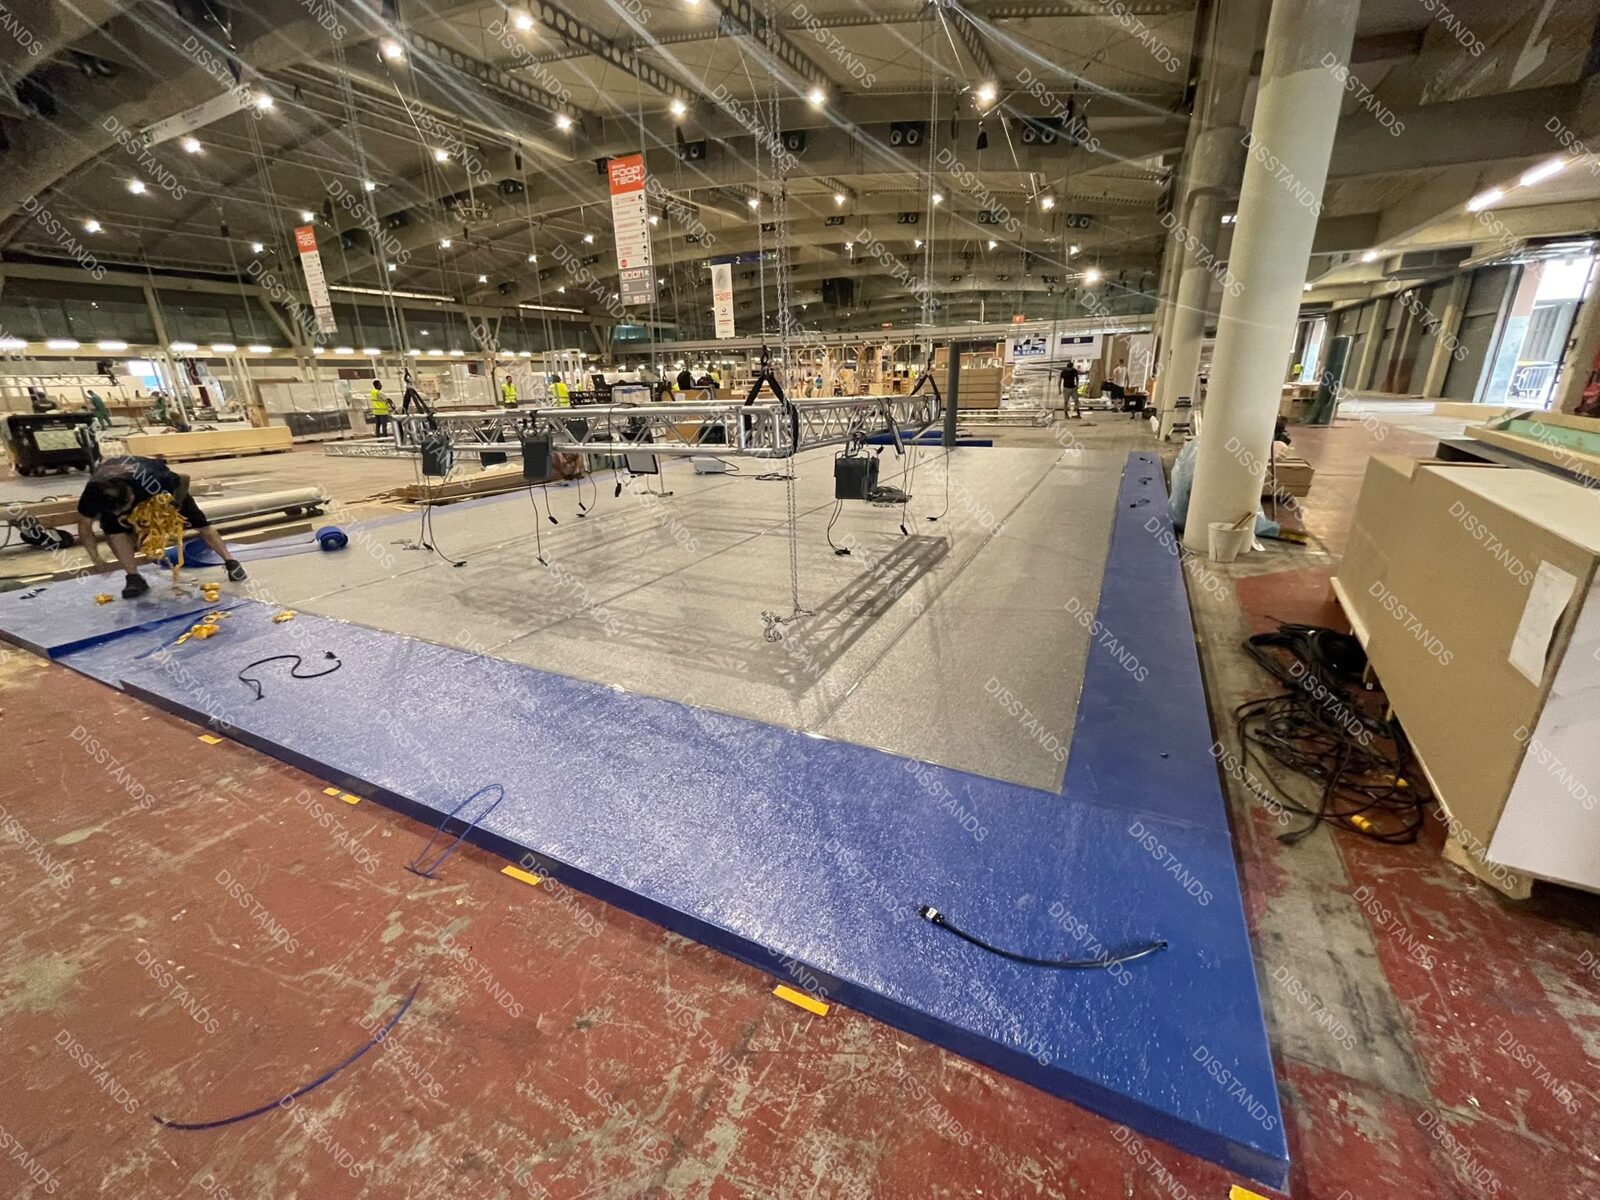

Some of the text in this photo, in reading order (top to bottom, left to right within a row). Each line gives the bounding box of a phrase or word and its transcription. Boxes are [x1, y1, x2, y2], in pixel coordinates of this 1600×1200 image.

[612, 166, 640, 178] FOOD
[613, 174, 641, 186] TECH
[735, 256, 741, 264] 2
